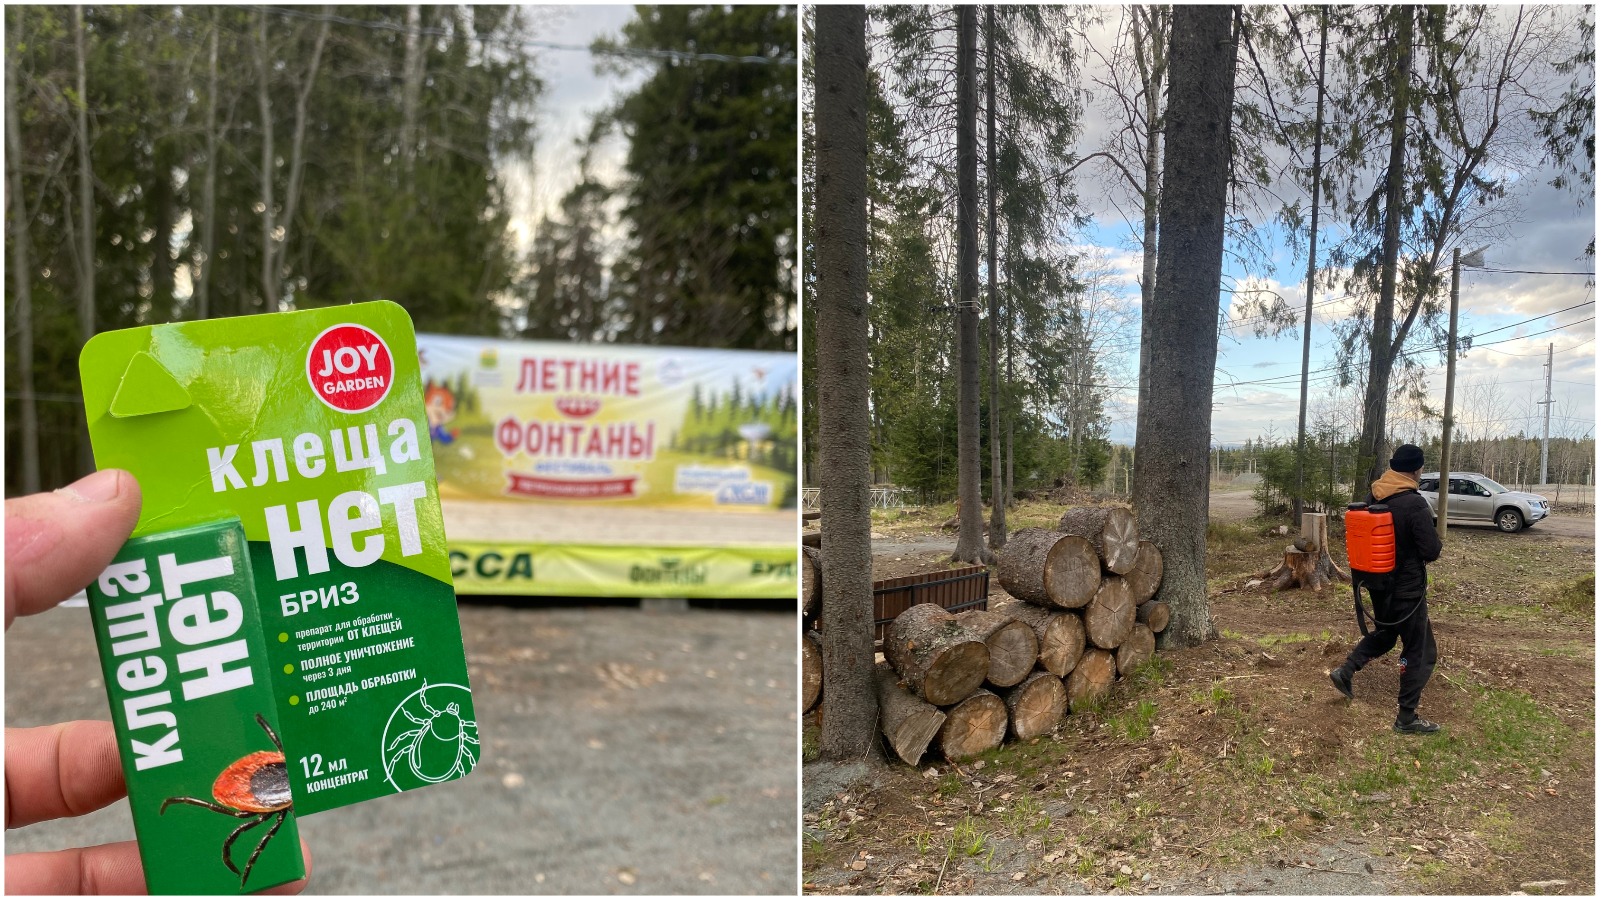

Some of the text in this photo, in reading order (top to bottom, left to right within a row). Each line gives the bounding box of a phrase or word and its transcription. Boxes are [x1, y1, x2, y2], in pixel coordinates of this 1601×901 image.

[318, 343, 381, 377] JOY
[516, 357, 641, 396] ЛЕТНИЕ
[323, 375, 385, 395] GARDEN
[206, 417, 421, 493] клеща
[496, 416, 656, 460] ФОНТАНЫ
[263, 481, 427, 582] нет
[279, 581, 361, 617] БРИЗ
[158, 553, 254, 702] нет
[295, 611, 394, 640] препарат для обработки
[297, 617, 403, 652] территории ОТ КЛЕЩЕЙ
[98, 557, 184, 772] клеща
[300, 636, 416, 672] ПОЛНОЕ УНИЧТОЖЕНИЕ
[302, 665, 352, 683] через 3 дня
[305, 668, 417, 703] ПЛОЩАДЬ ОБРАБОТКИ
[308, 704, 320, 716] до
[321, 699, 337, 713] 240
[299, 752, 325, 780] 12
[306, 768, 369, 794] КОНЦЕНТРАТ
